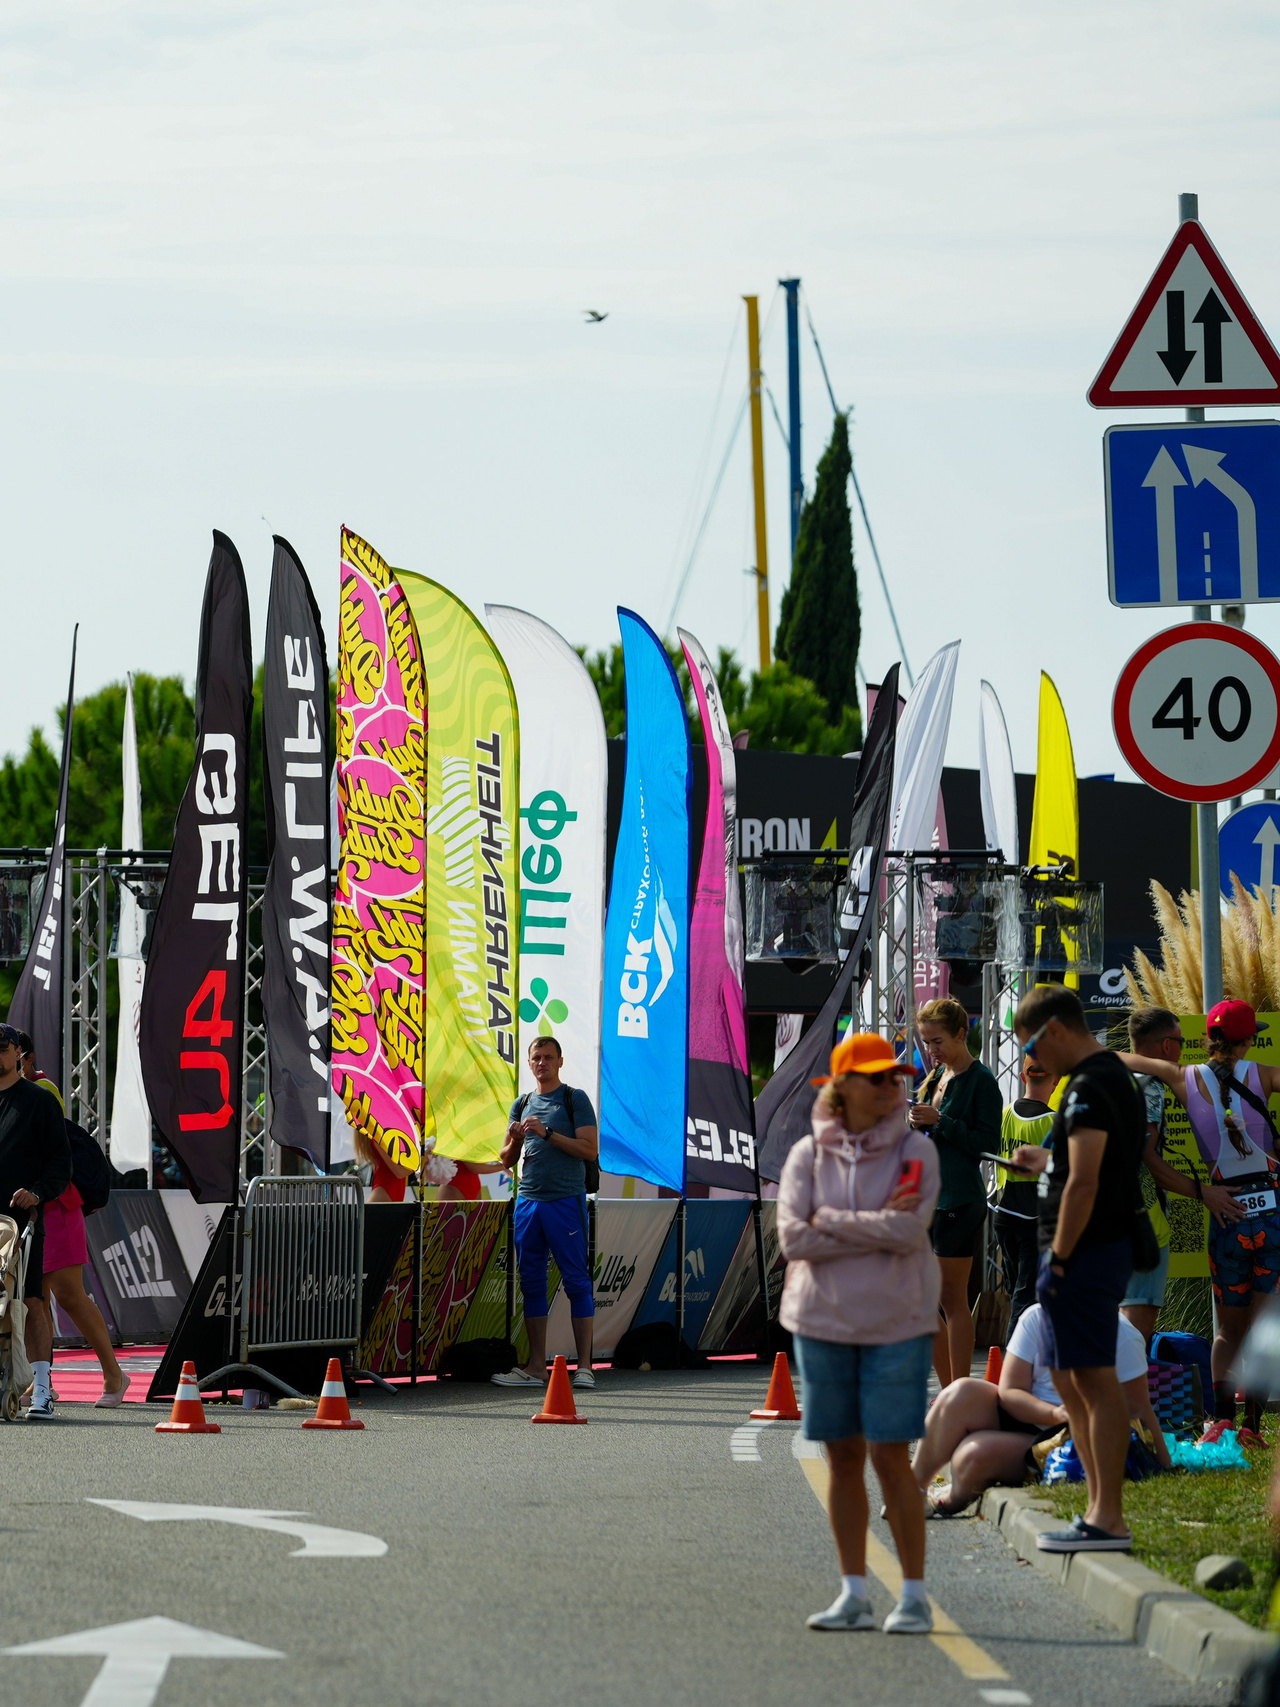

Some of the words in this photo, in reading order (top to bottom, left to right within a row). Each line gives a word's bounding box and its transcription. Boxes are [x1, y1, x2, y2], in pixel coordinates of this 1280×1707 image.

[1152, 675, 1252, 743] 40
[735, 817, 811, 858] IRON
[1183, 1052, 1208, 1061] прове
[102, 1225, 177, 1298] TELE2
[597, 1255, 638, 1302] Шеф
